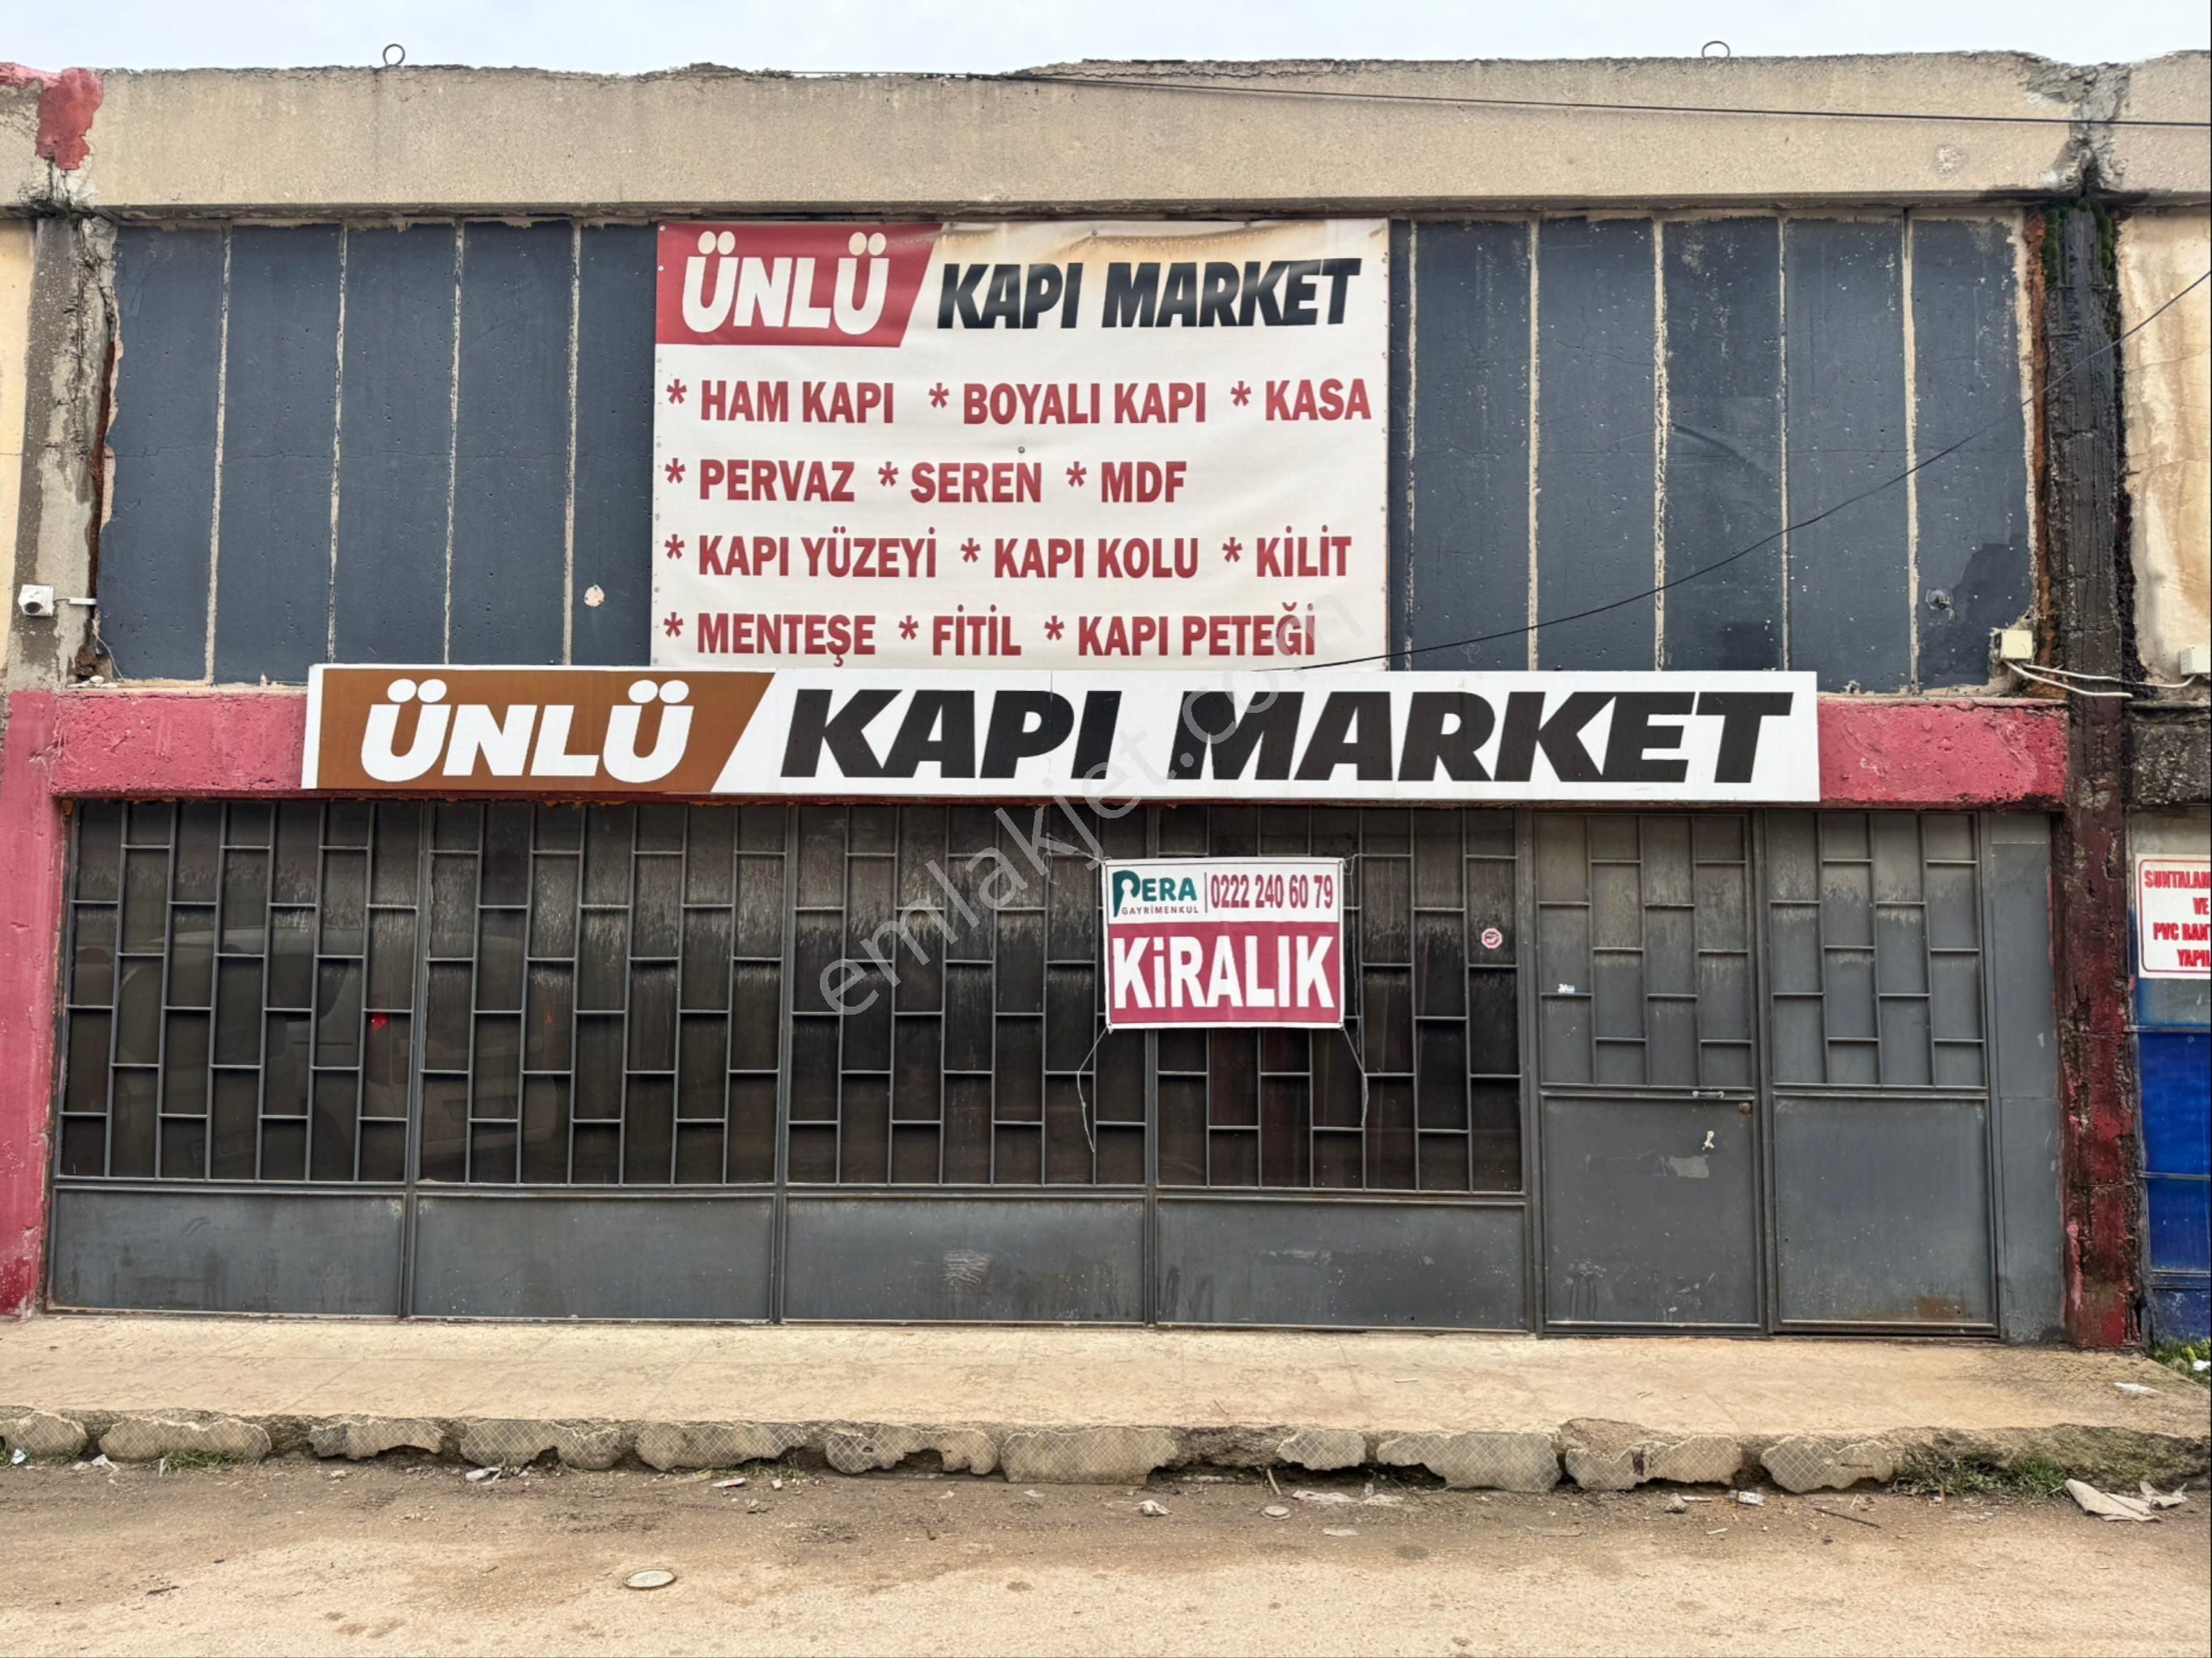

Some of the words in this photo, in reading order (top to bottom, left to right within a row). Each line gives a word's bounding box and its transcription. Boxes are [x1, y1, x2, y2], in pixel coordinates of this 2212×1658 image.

[682, 231, 889, 334] ÜNLÜ
[936, 262, 1084, 329] KAPI
[1102, 257, 1361, 329] MARKET
[702, 381, 789, 422] HAM
[803, 382, 894, 423] KAPI
[964, 384, 1101, 425] BOYALI
[1114, 383, 1206, 424] KAPI
[1266, 379, 1371, 422] KASA
[700, 460, 856, 502] PERVAZ
[911, 463, 1042, 504] SEREN
[1102, 461, 1187, 503] MDF
[699, 536, 789, 577] KAPI
[802, 526, 936, 578] YÜZEYİ
[996, 539, 1085, 579] KAPI
[1098, 538, 1199, 579] KOLU
[1257, 524, 1352, 578] KİLİT
[698, 613, 876, 667] MENTEŞE
[933, 604, 1021, 656] FİTİL
[1079, 617, 1169, 656] KAPI
[1182, 602, 1316, 657] PETEĞİ
[361, 679, 694, 782] ÜNLÜ
[780, 689, 1123, 780] KAPI
[1168, 690, 1794, 783] MARKET
[1112, 869, 1198, 917] PERA
[1210, 874, 1250, 909] 0222
[1255, 874, 1284, 908] 240
[1289, 875, 1308, 908] 60
[1314, 875, 1334, 909] 79
[1121, 905, 1199, 915] GAYRİMENKUL
[2193, 897, 2210, 915] VE
[2153, 922, 2180, 941] PVC
